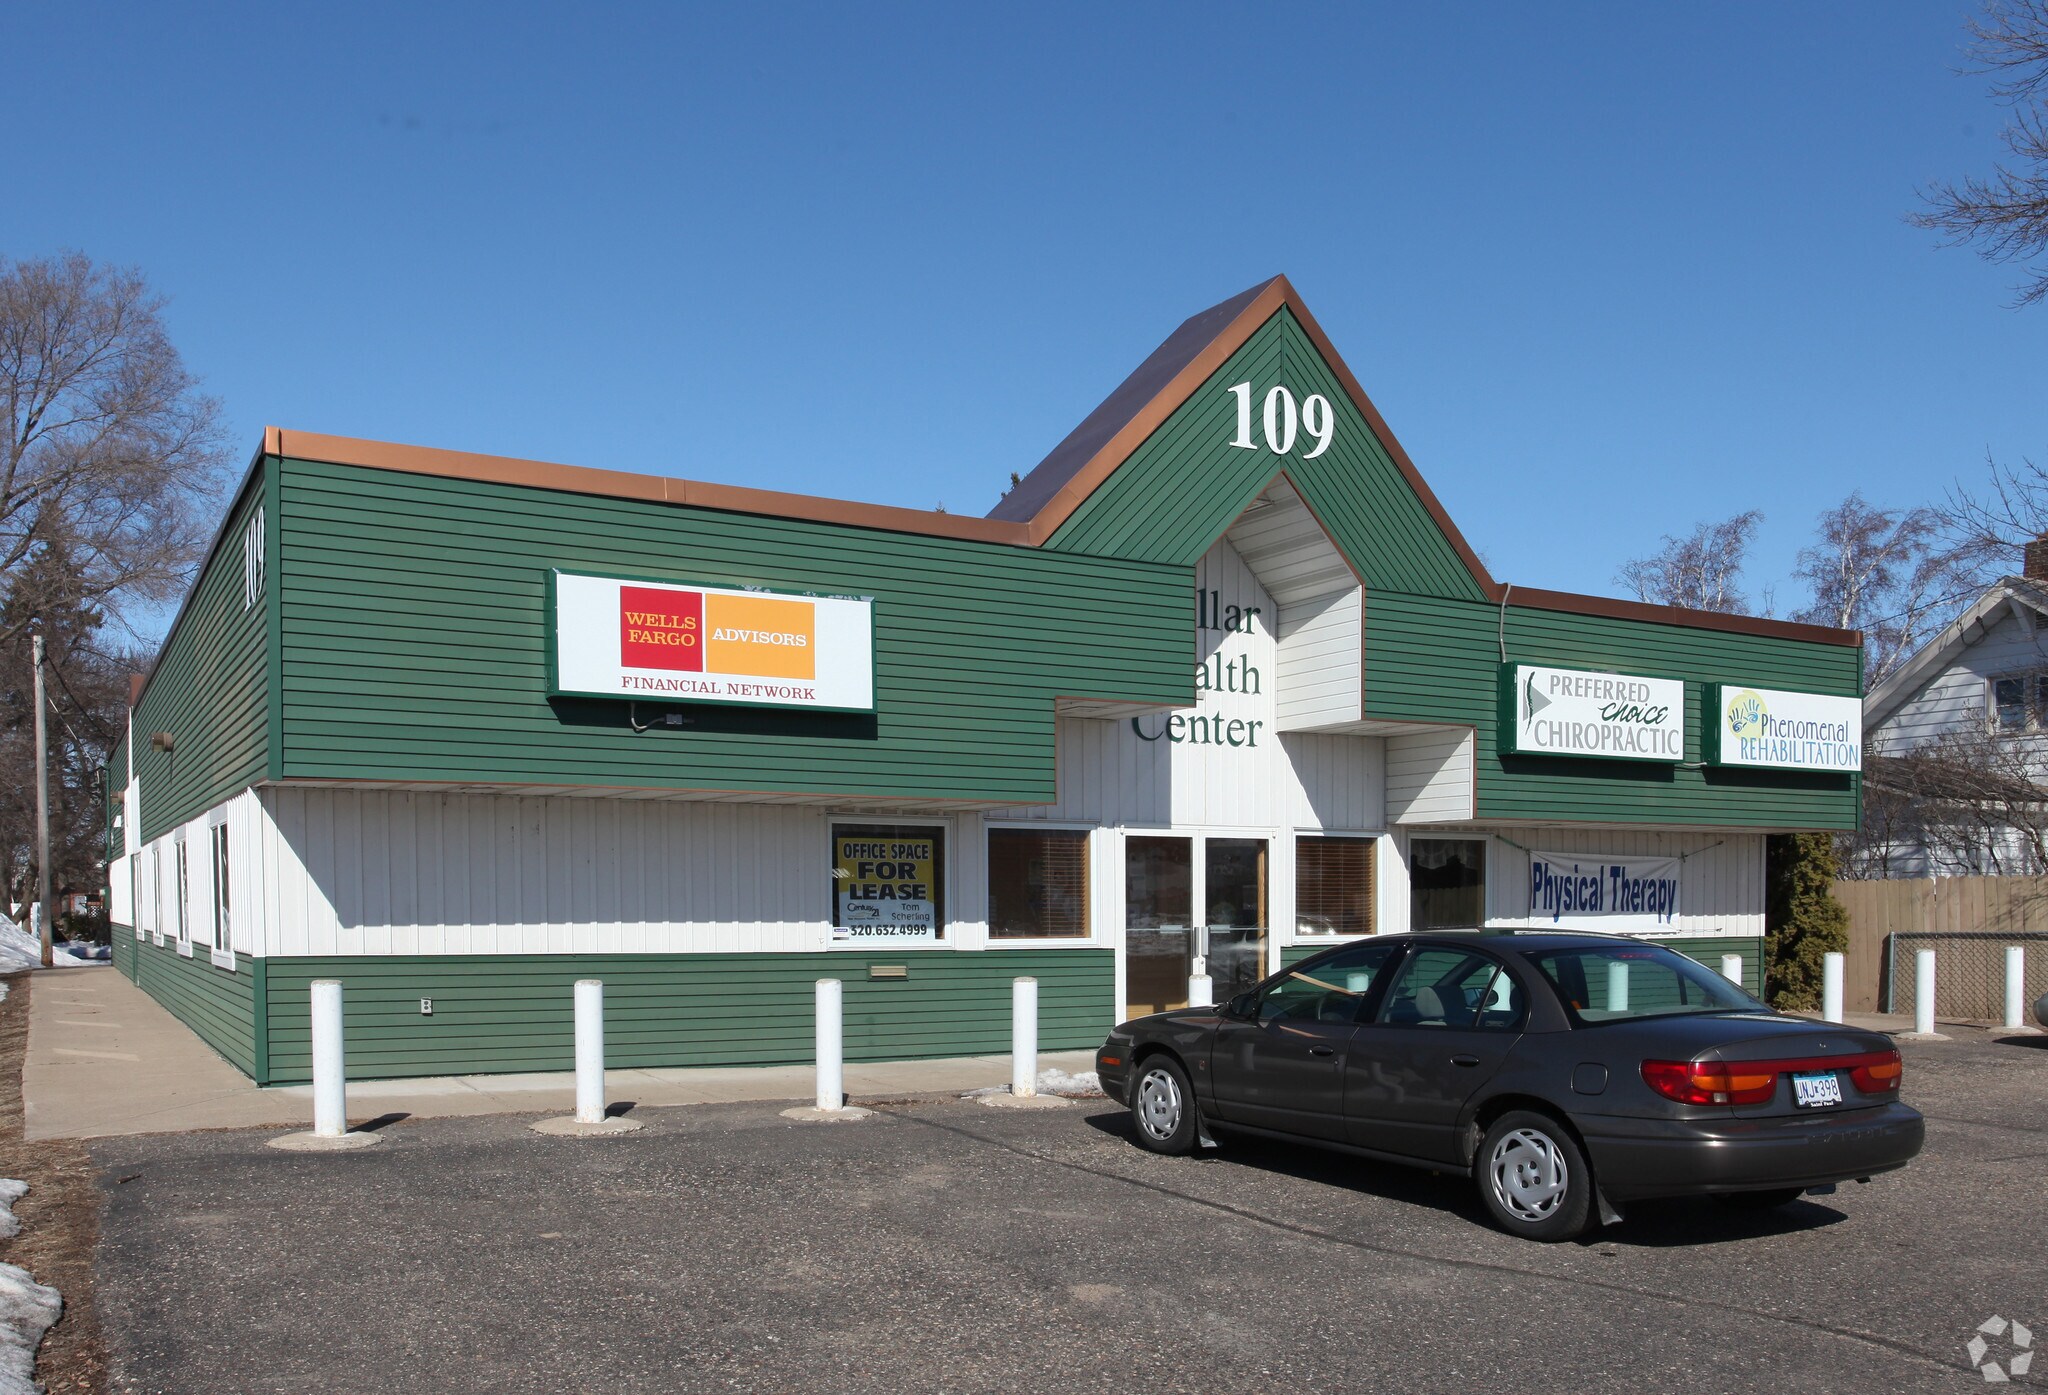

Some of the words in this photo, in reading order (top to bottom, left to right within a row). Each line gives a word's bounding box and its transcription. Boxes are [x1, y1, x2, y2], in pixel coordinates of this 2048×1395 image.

[1227, 381, 1335, 459] 109
[624, 611, 697, 630] WELLS
[1197, 588, 1261, 634] llar
[628, 629, 696, 647] FARGO
[711, 627, 807, 647] ADVISORS
[1196, 651, 1261, 694] alth
[621, 675, 722, 694] FINANCIAL
[727, 683, 816, 700] NETWORK
[1549, 674, 1650, 703] PREFERRED
[1534, 719, 1680, 756] CHIROPRACTIC
[1761, 713, 1849, 743] Phenomenal
[1740, 736, 1859, 767] REHABILITATION
[843, 843, 886, 859] OFFICE
[891, 844, 929, 859] SPACE
[858, 862, 916, 879] FOR
[849, 884, 926, 900] LEASE
[1532, 862, 1605, 923] Physical
[1610, 866, 1677, 924] Therapy
[891, 912, 930, 921] Scherling
[902, 903, 920, 911] Tom
[850, 924, 927, 936] 320.632.4999
[1819, 1079, 1838, 1097] 398
